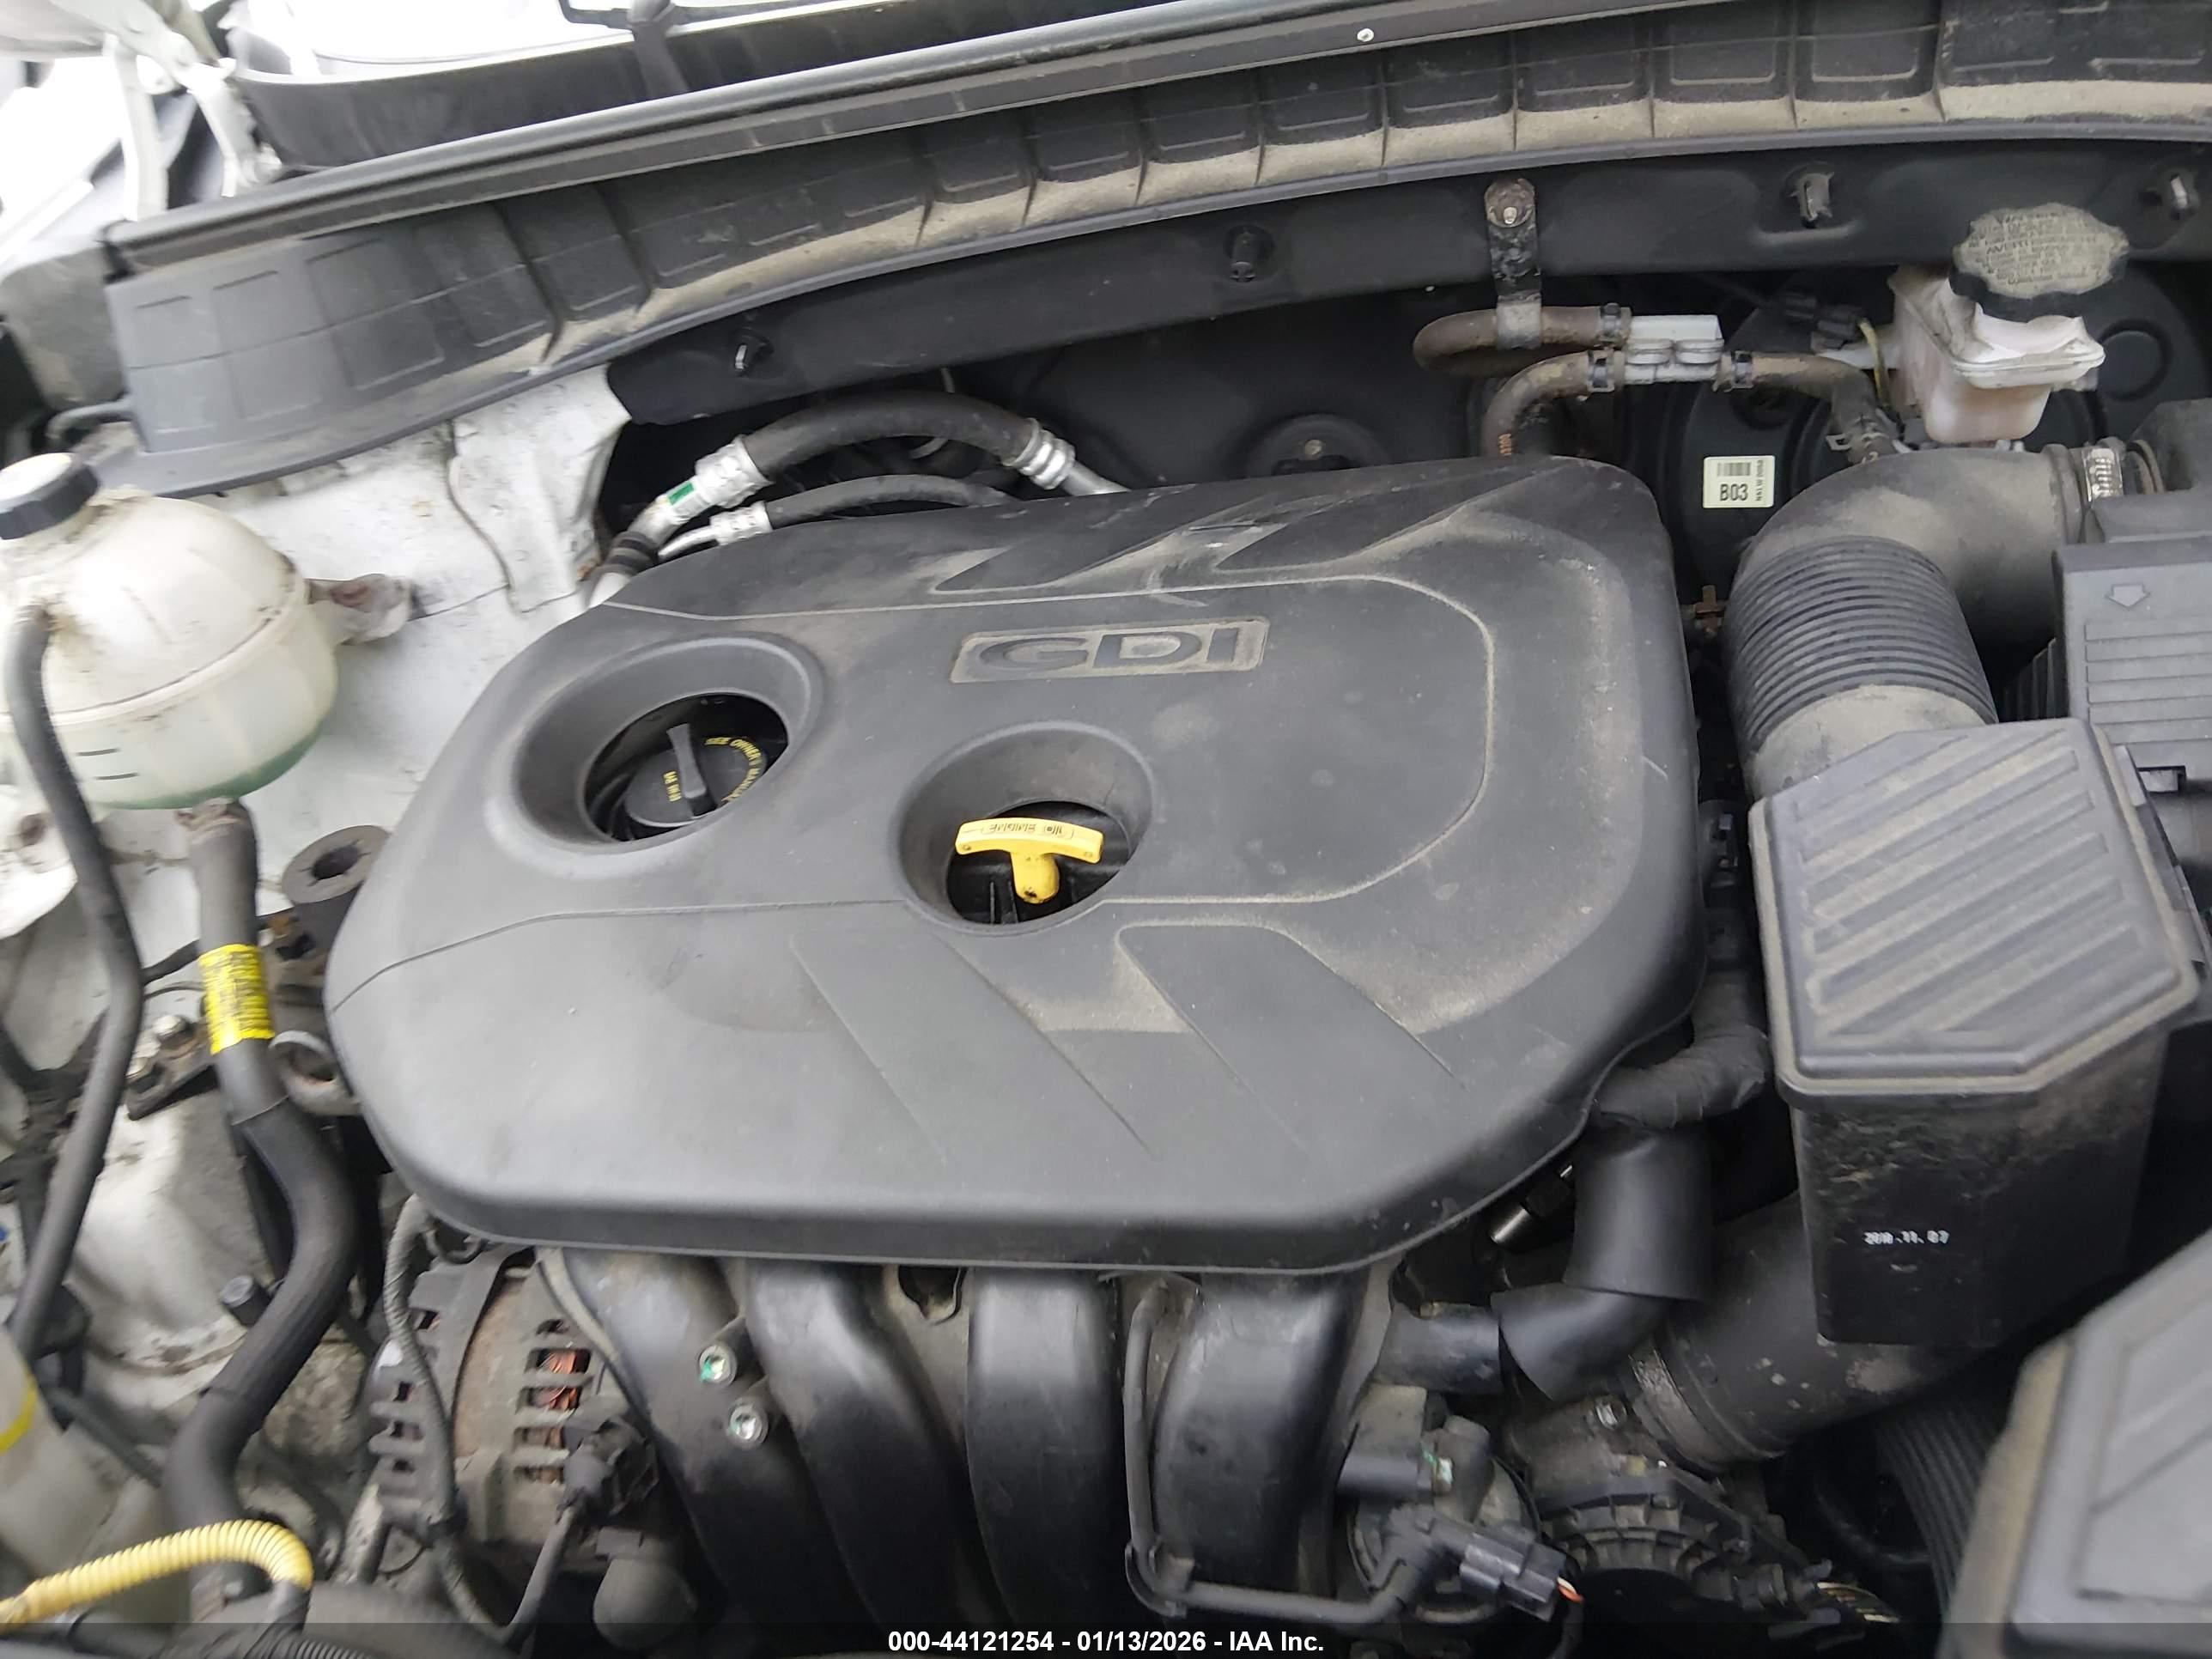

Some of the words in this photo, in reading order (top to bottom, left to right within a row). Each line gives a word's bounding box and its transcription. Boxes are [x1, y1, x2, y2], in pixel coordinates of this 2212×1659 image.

[1720, 483, 1748, 501] B03
[979, 628, 1240, 671] GDI
[987, 822, 1037, 834] ENGINE
